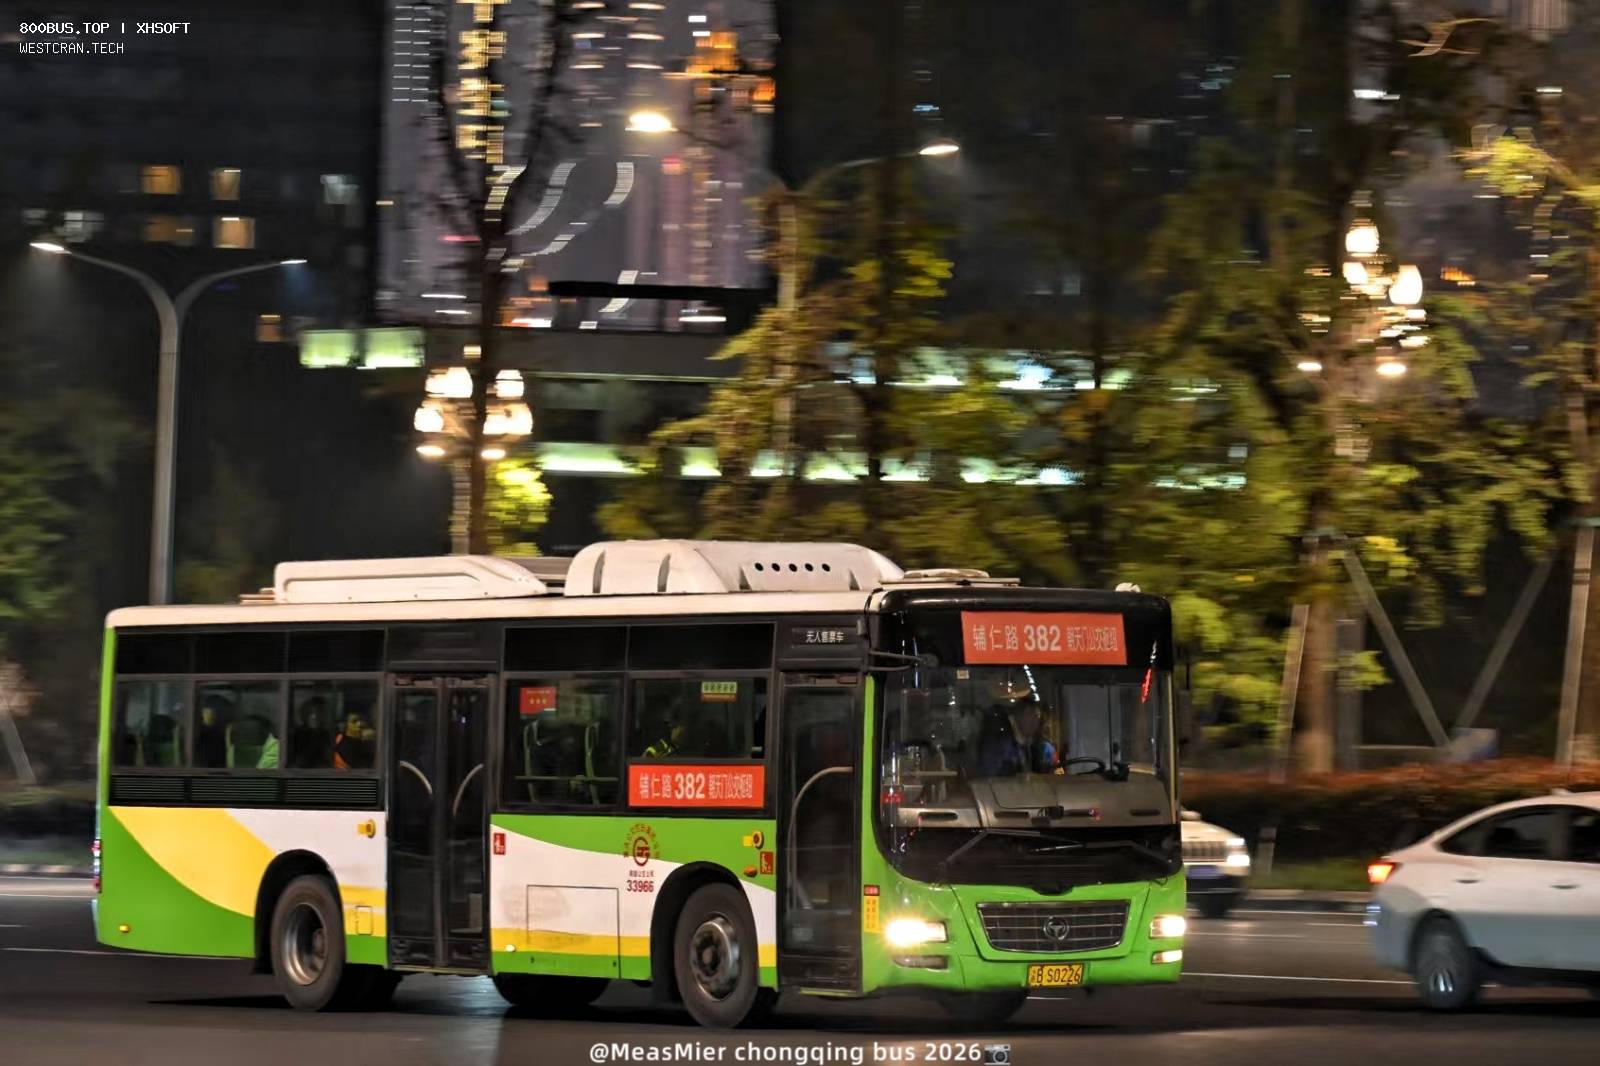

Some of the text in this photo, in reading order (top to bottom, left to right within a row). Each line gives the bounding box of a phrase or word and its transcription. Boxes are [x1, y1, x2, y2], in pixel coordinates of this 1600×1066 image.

[973, 625, 1018, 651] 辅仁路
[1023, 624, 1062, 651] 382
[674, 772, 706, 800] 382
